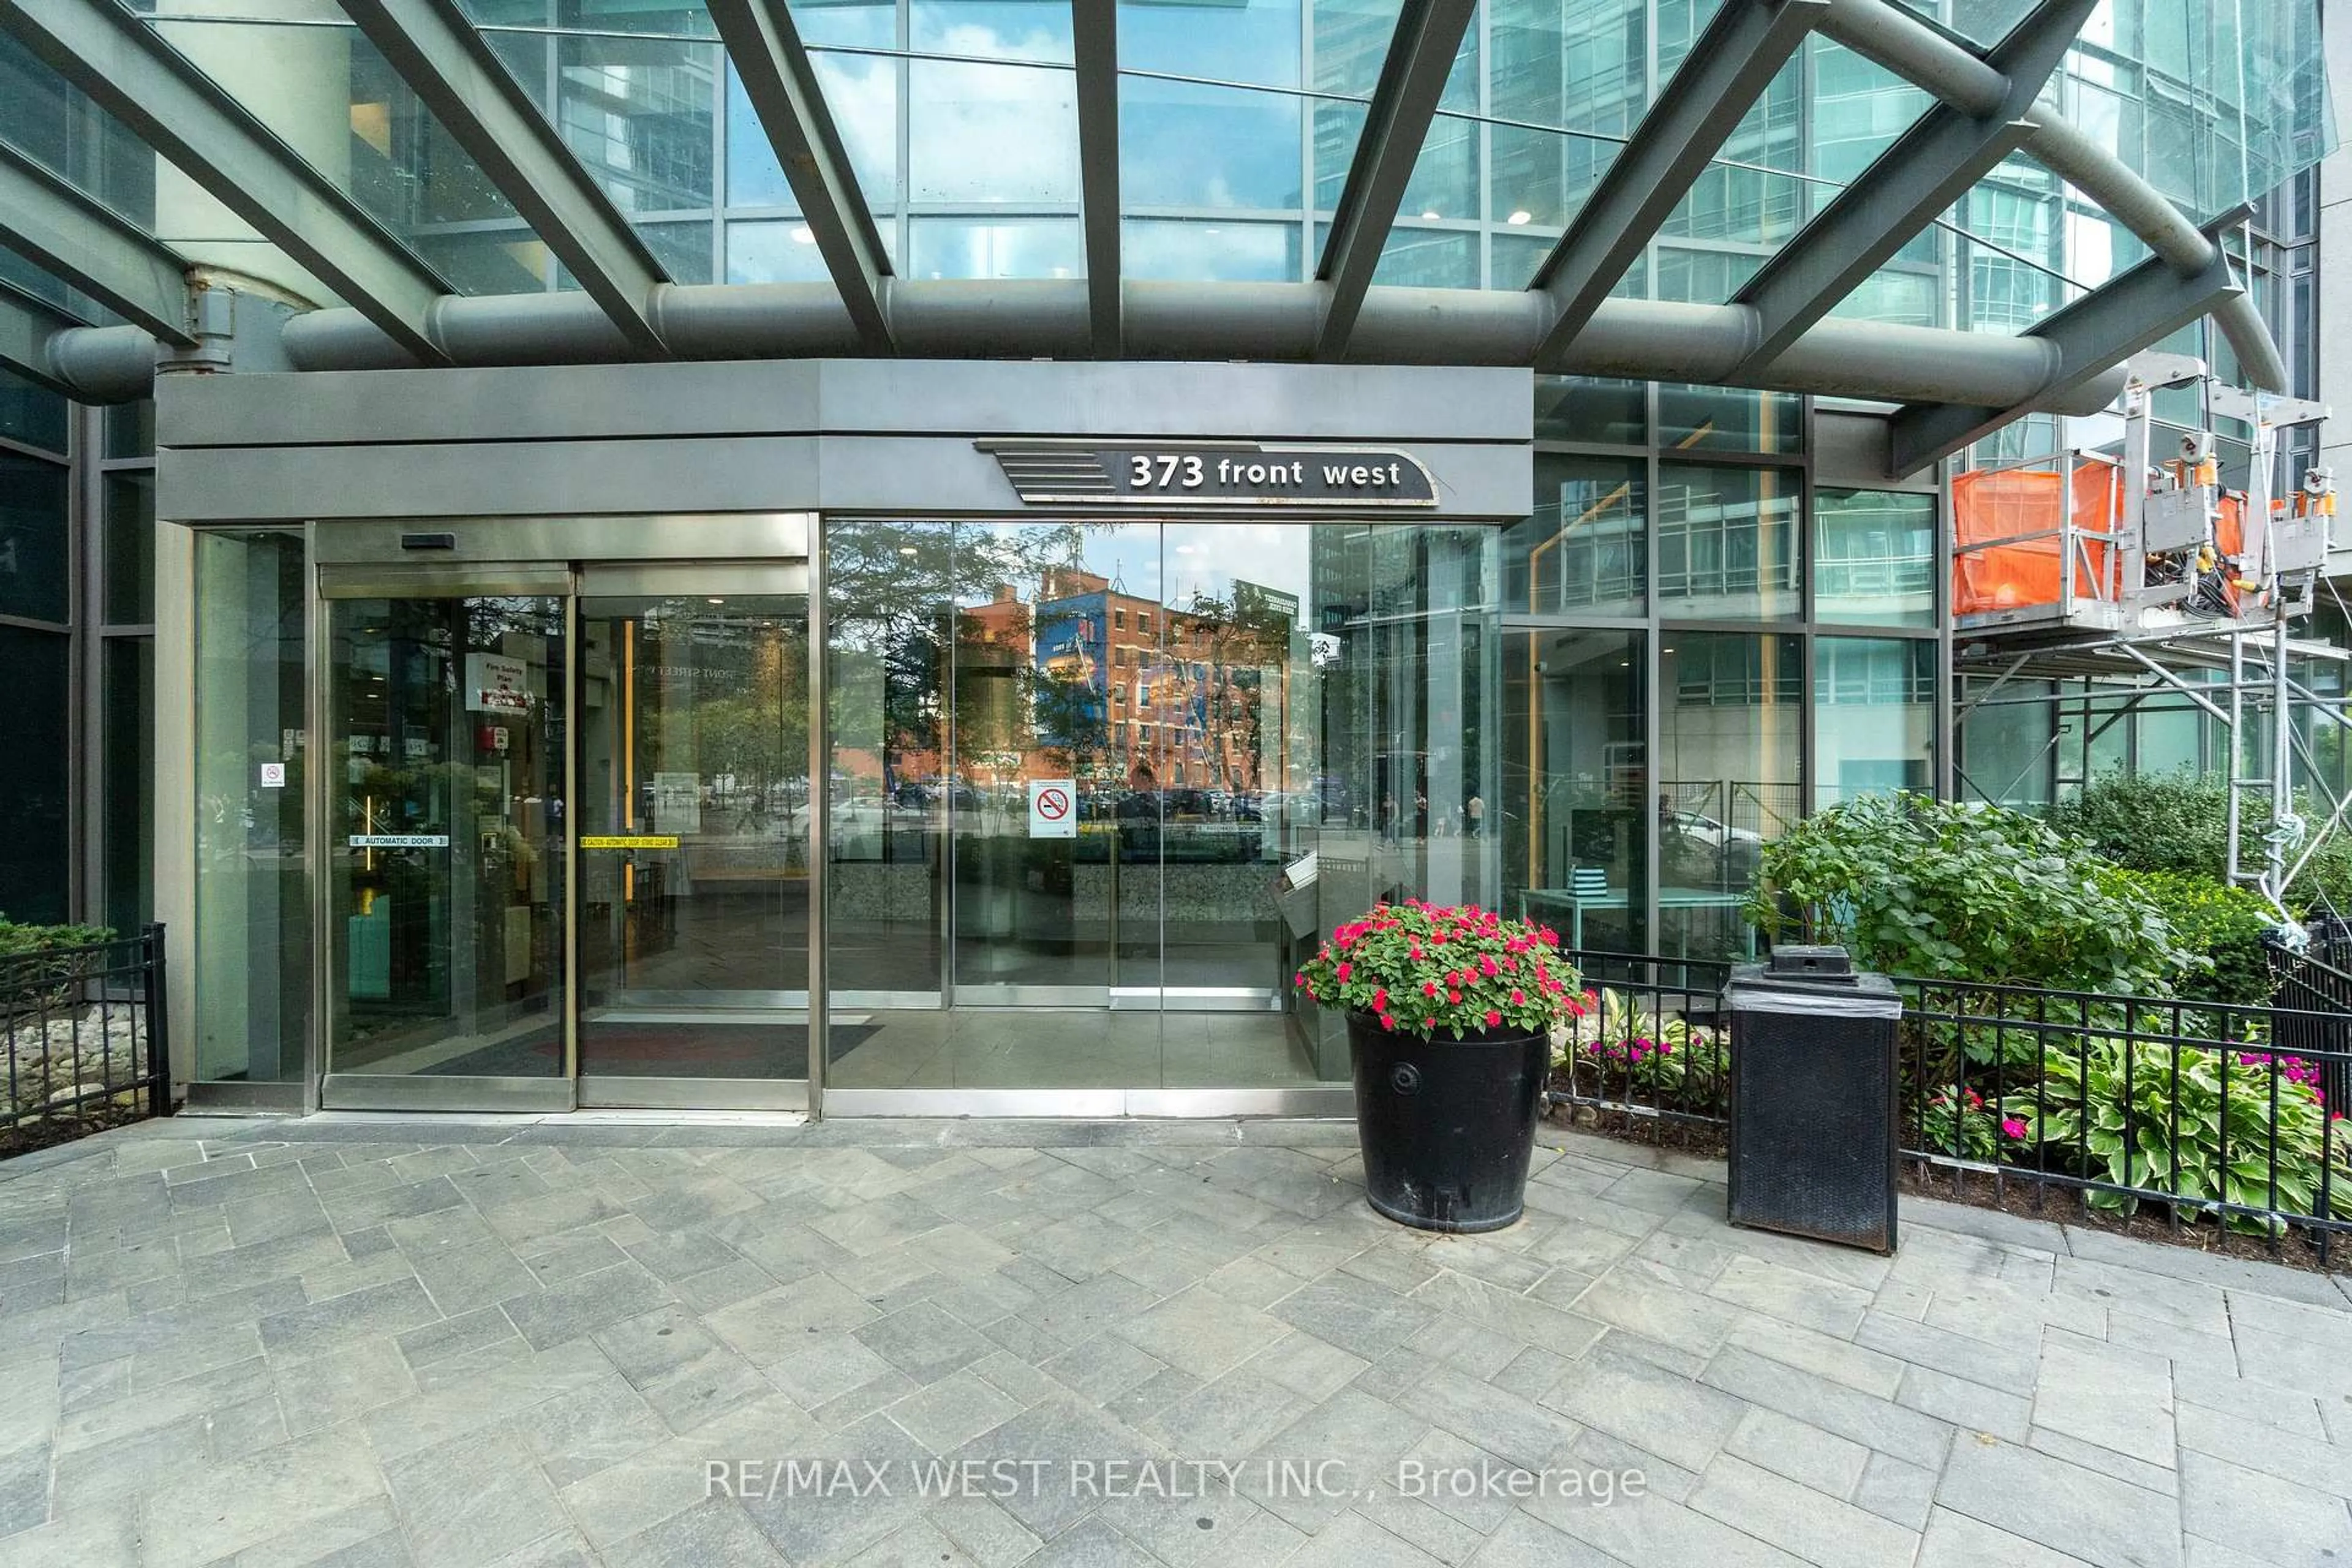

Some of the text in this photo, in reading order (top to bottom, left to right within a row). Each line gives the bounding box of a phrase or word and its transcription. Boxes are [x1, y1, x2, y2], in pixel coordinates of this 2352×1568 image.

[1130, 455, 1400, 487] 373 front west
